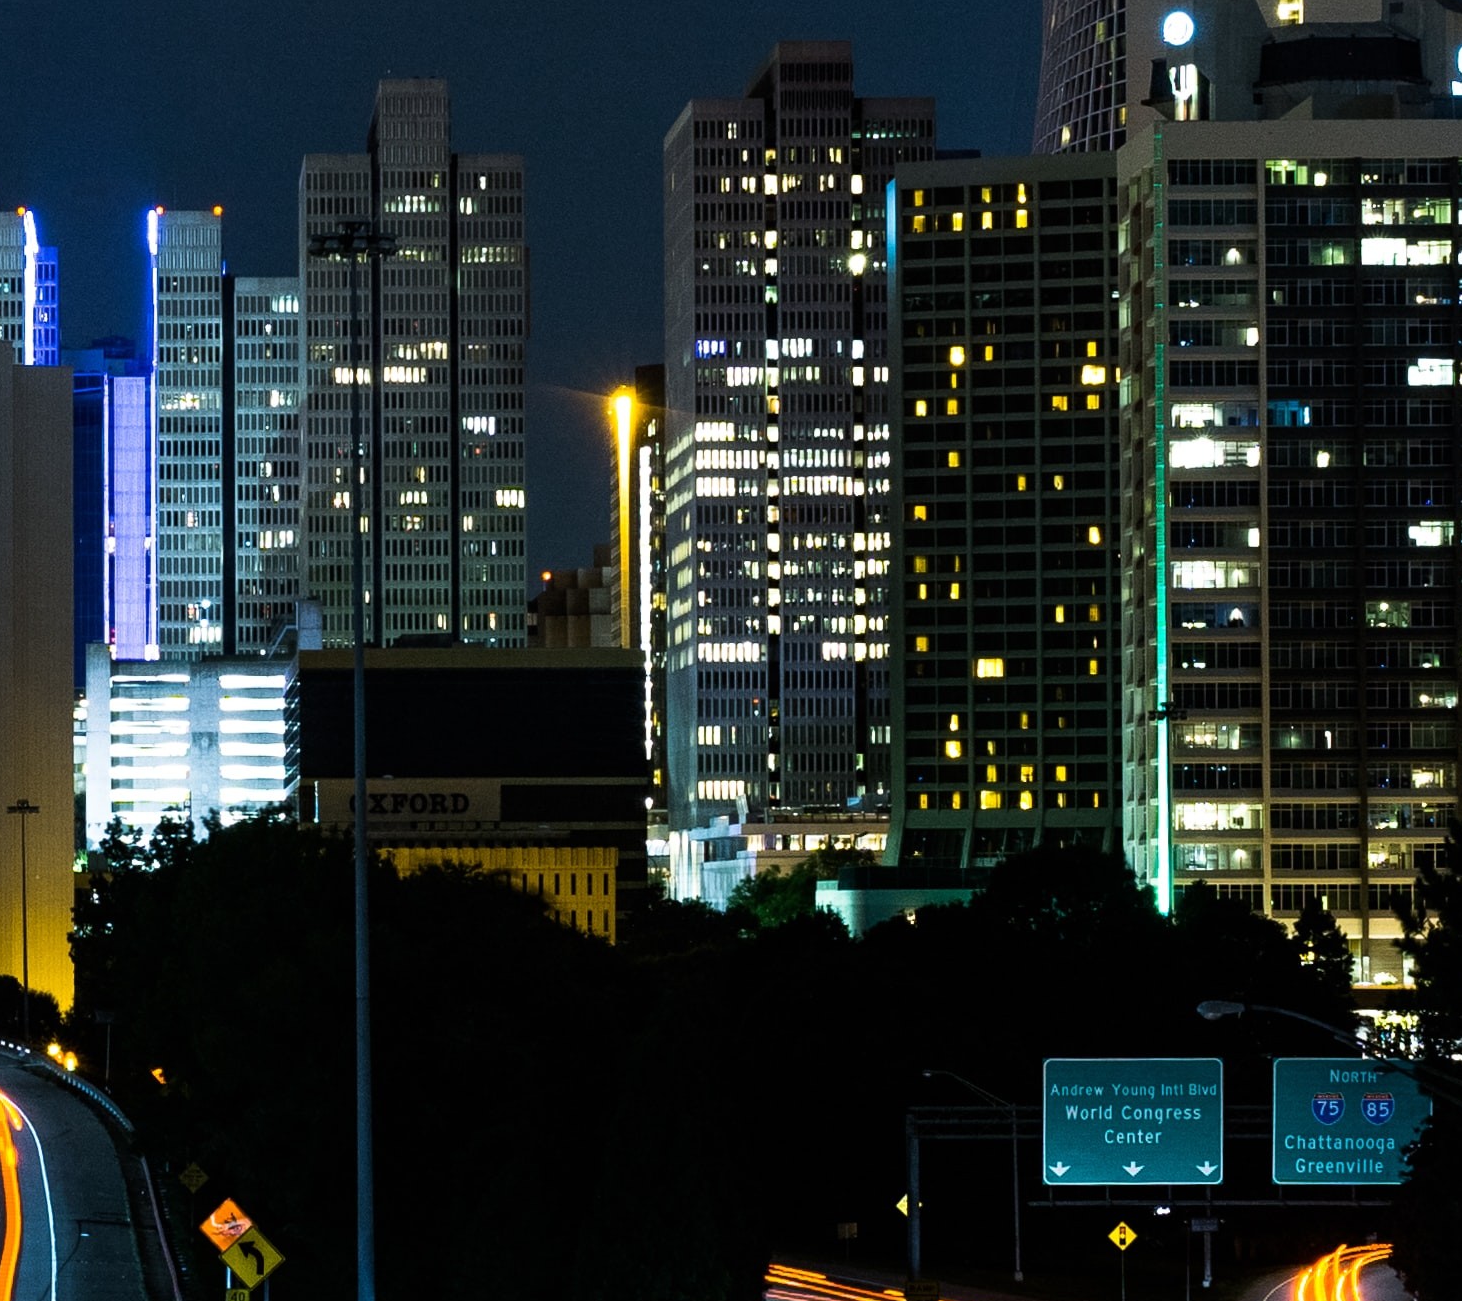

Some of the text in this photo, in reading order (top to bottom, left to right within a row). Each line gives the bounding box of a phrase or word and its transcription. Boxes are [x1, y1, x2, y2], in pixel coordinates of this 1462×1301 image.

[1329, 1069, 1377, 1084] NORTH
[1050, 1083, 1217, 1100] Andrew Young Intl Blvd
[1065, 1105, 1202, 1125] World Congress
[1317, 1100, 1390, 1117] 75 85
[1104, 1128, 1163, 1144] Center
[1284, 1134, 1395, 1155] Chattanooga
[1295, 1158, 1384, 1174] Greenville
